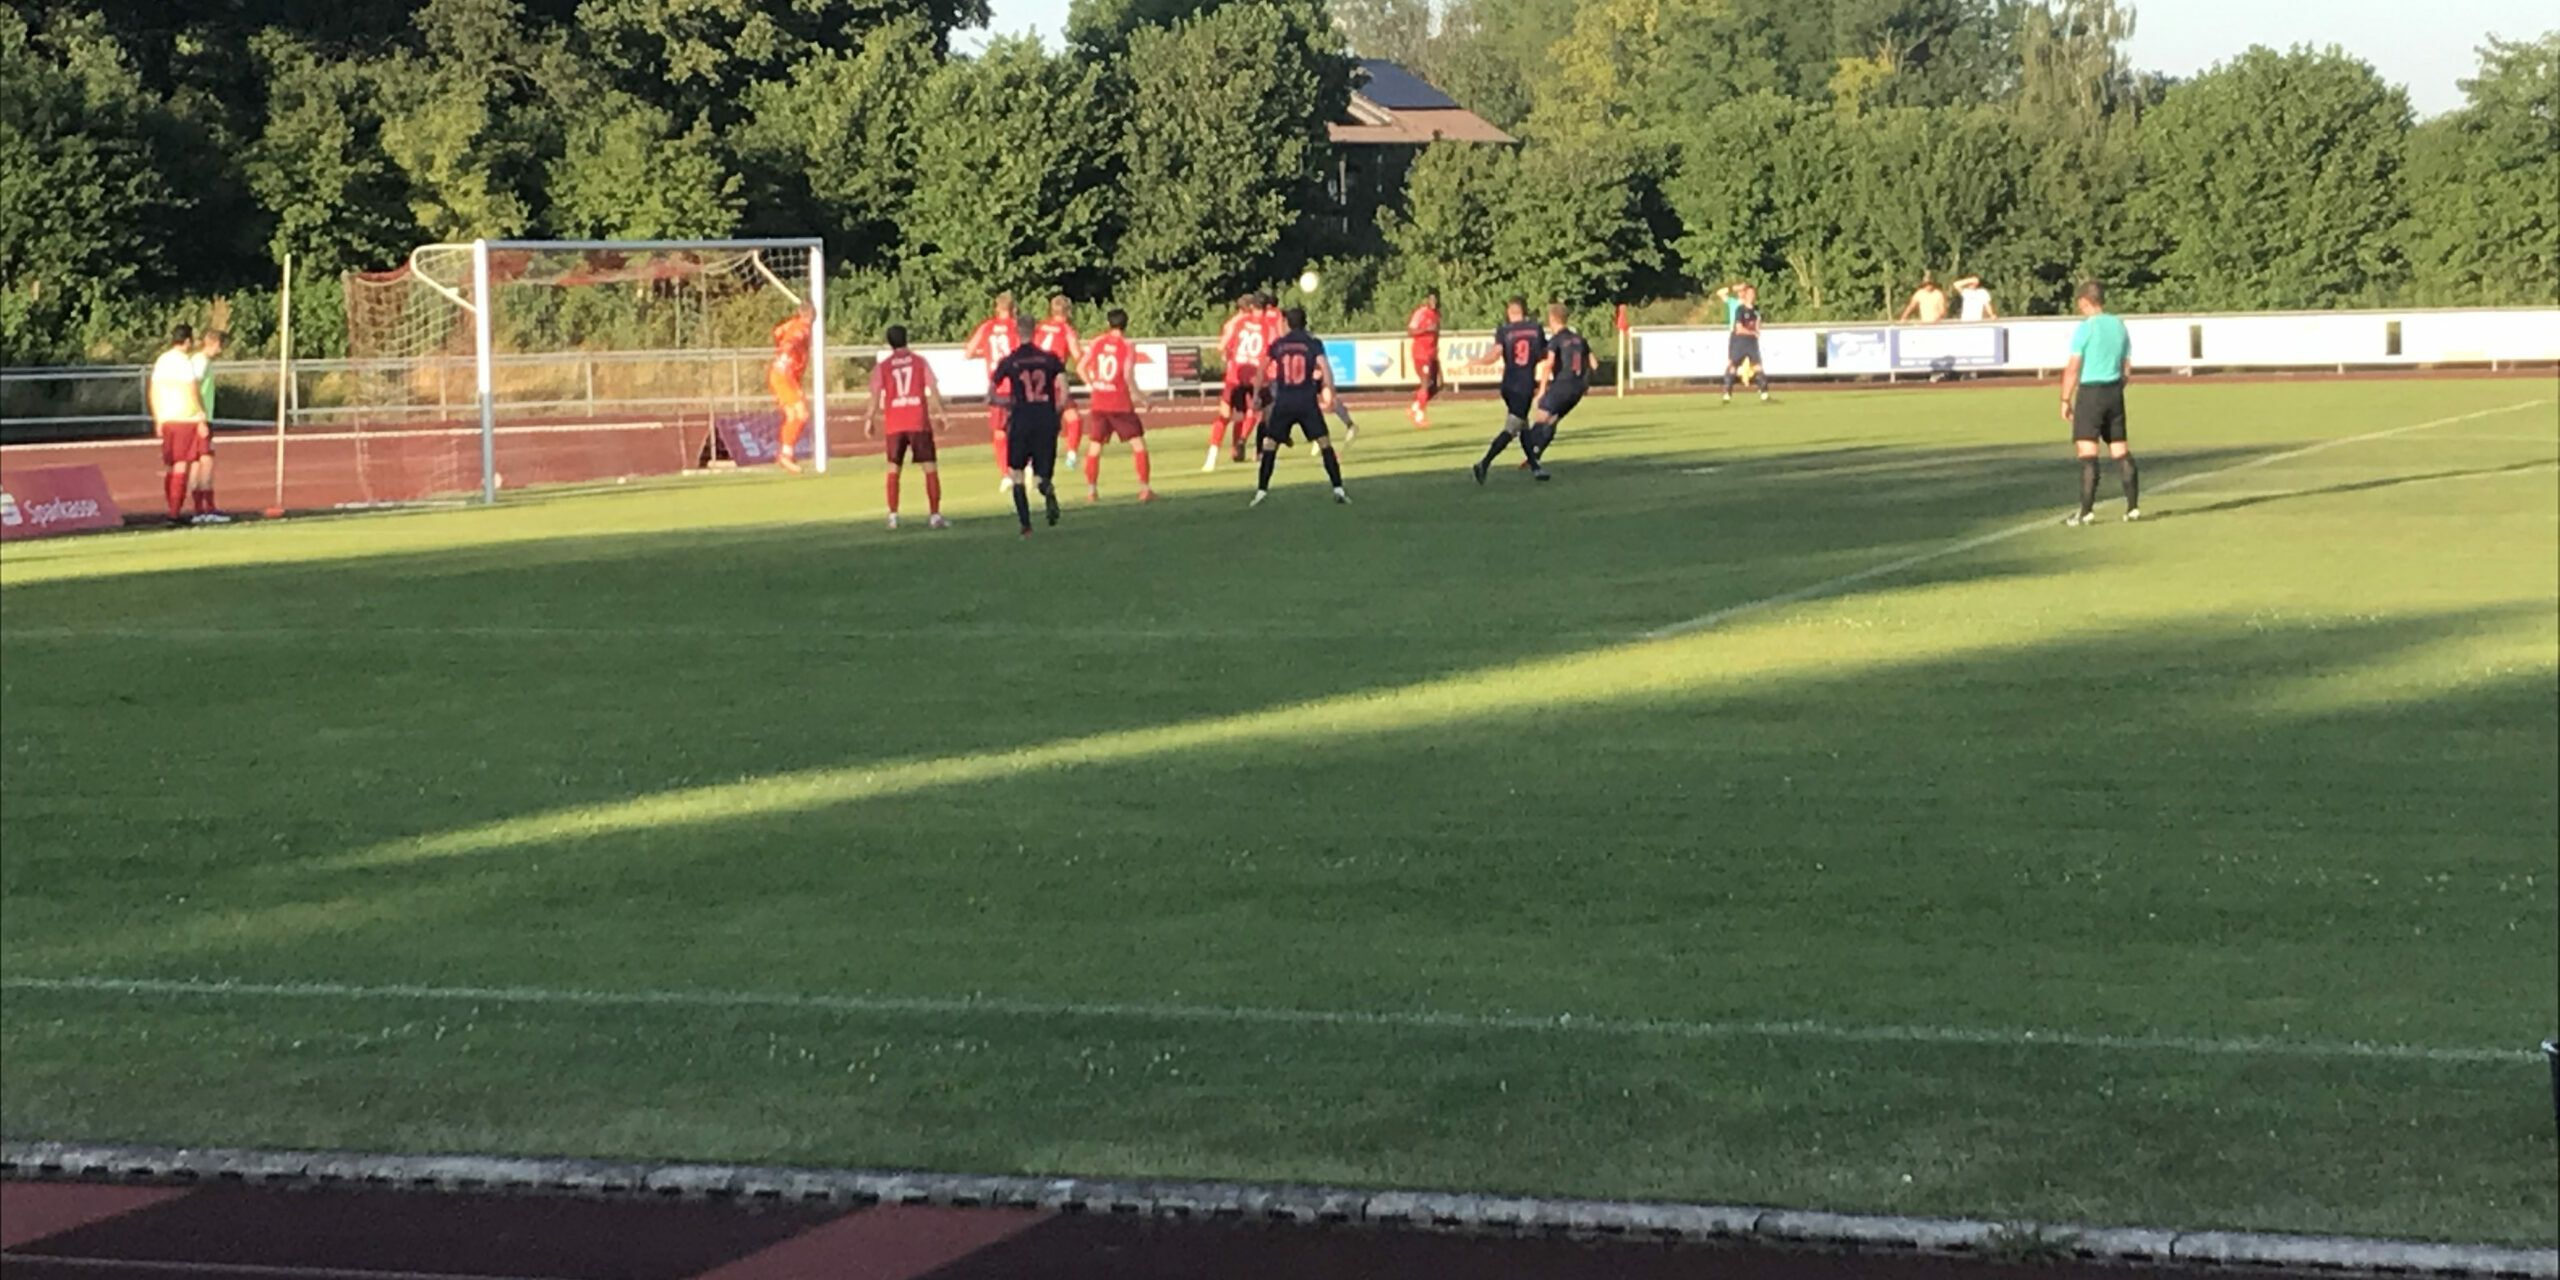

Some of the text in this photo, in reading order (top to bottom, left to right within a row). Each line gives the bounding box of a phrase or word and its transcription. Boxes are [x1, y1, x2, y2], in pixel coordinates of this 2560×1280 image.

[1238, 329, 1262, 357] 20
[1514, 339, 1530, 367] 9
[892, 366, 913, 397] 17
[1097, 353, 1117, 382] 10
[1282, 353, 1306, 385] 10
[1020, 368, 1049, 403] 12
[23, 497, 101, 528] Sparkasse
